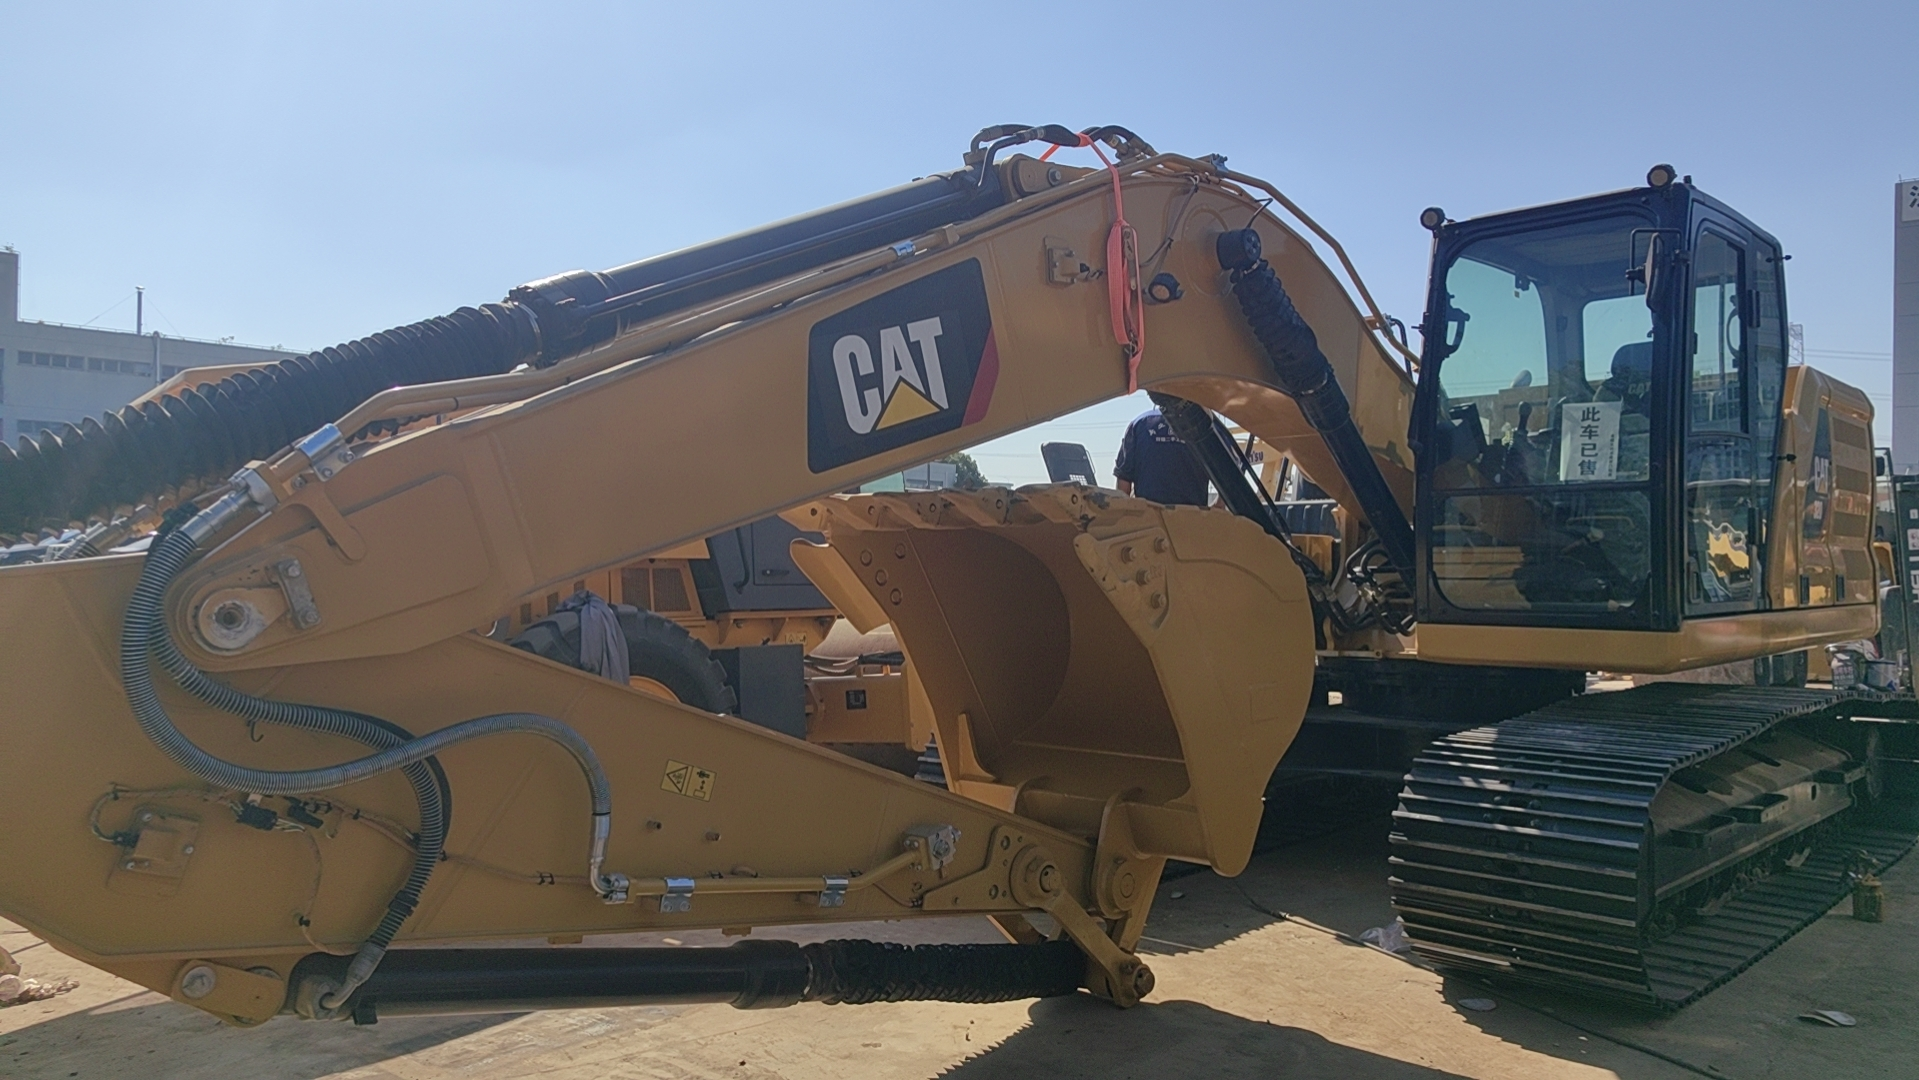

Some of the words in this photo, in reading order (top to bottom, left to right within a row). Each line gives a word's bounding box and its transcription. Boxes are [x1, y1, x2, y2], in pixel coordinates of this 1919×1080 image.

[832, 316, 949, 435] CAT
[1578, 406, 1601, 476] 此车已售
[1814, 456, 1829, 494] CAT
